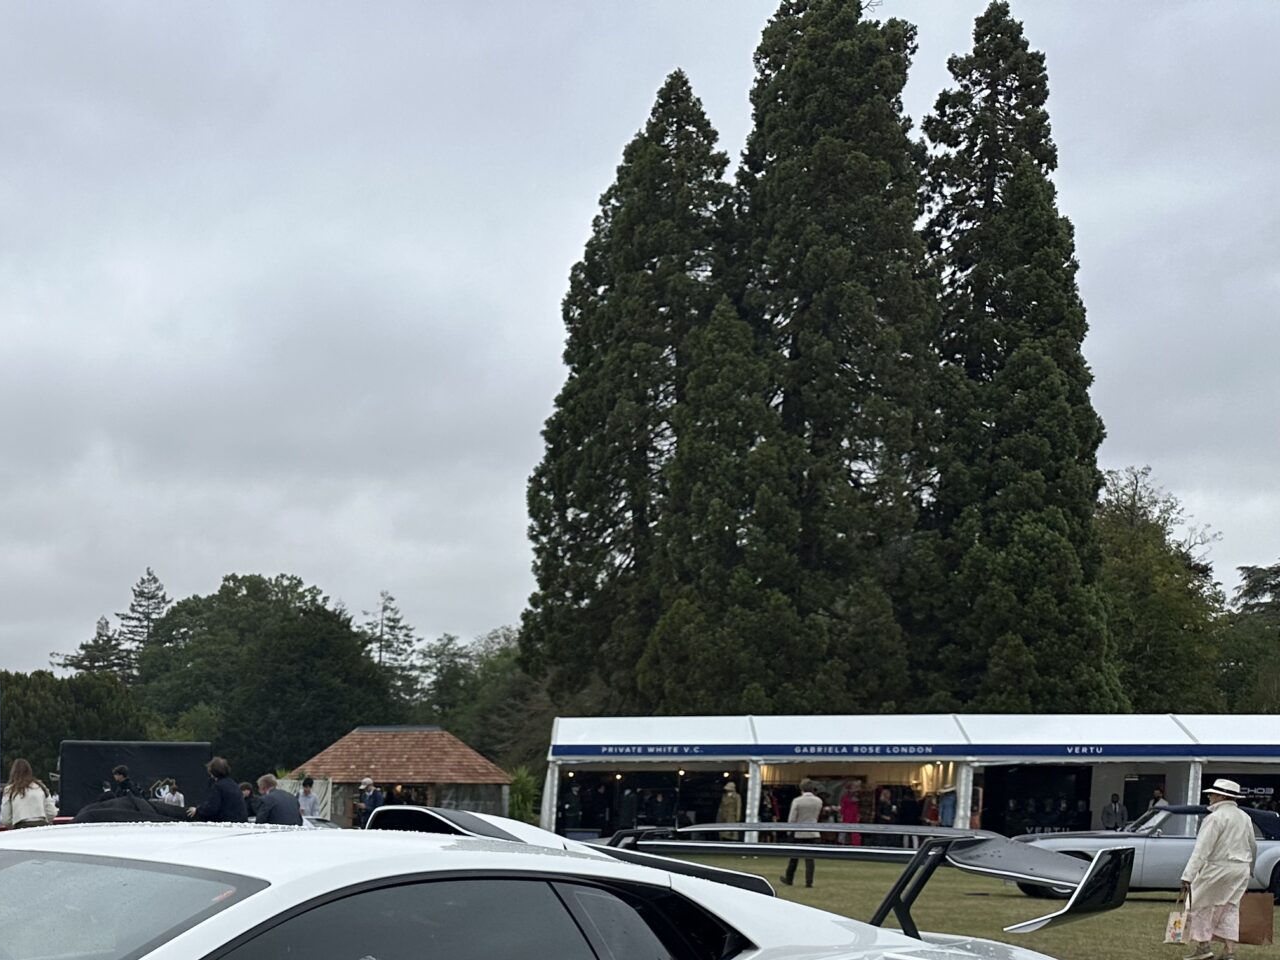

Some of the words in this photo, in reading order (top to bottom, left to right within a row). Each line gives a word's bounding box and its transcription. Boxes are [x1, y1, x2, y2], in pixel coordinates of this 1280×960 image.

[794, 746, 848, 754] GABRIELA
[853, 746, 880, 754] ROSE
[886, 746, 933, 754] LONDON
[1066, 746, 1103, 754] VERTU
